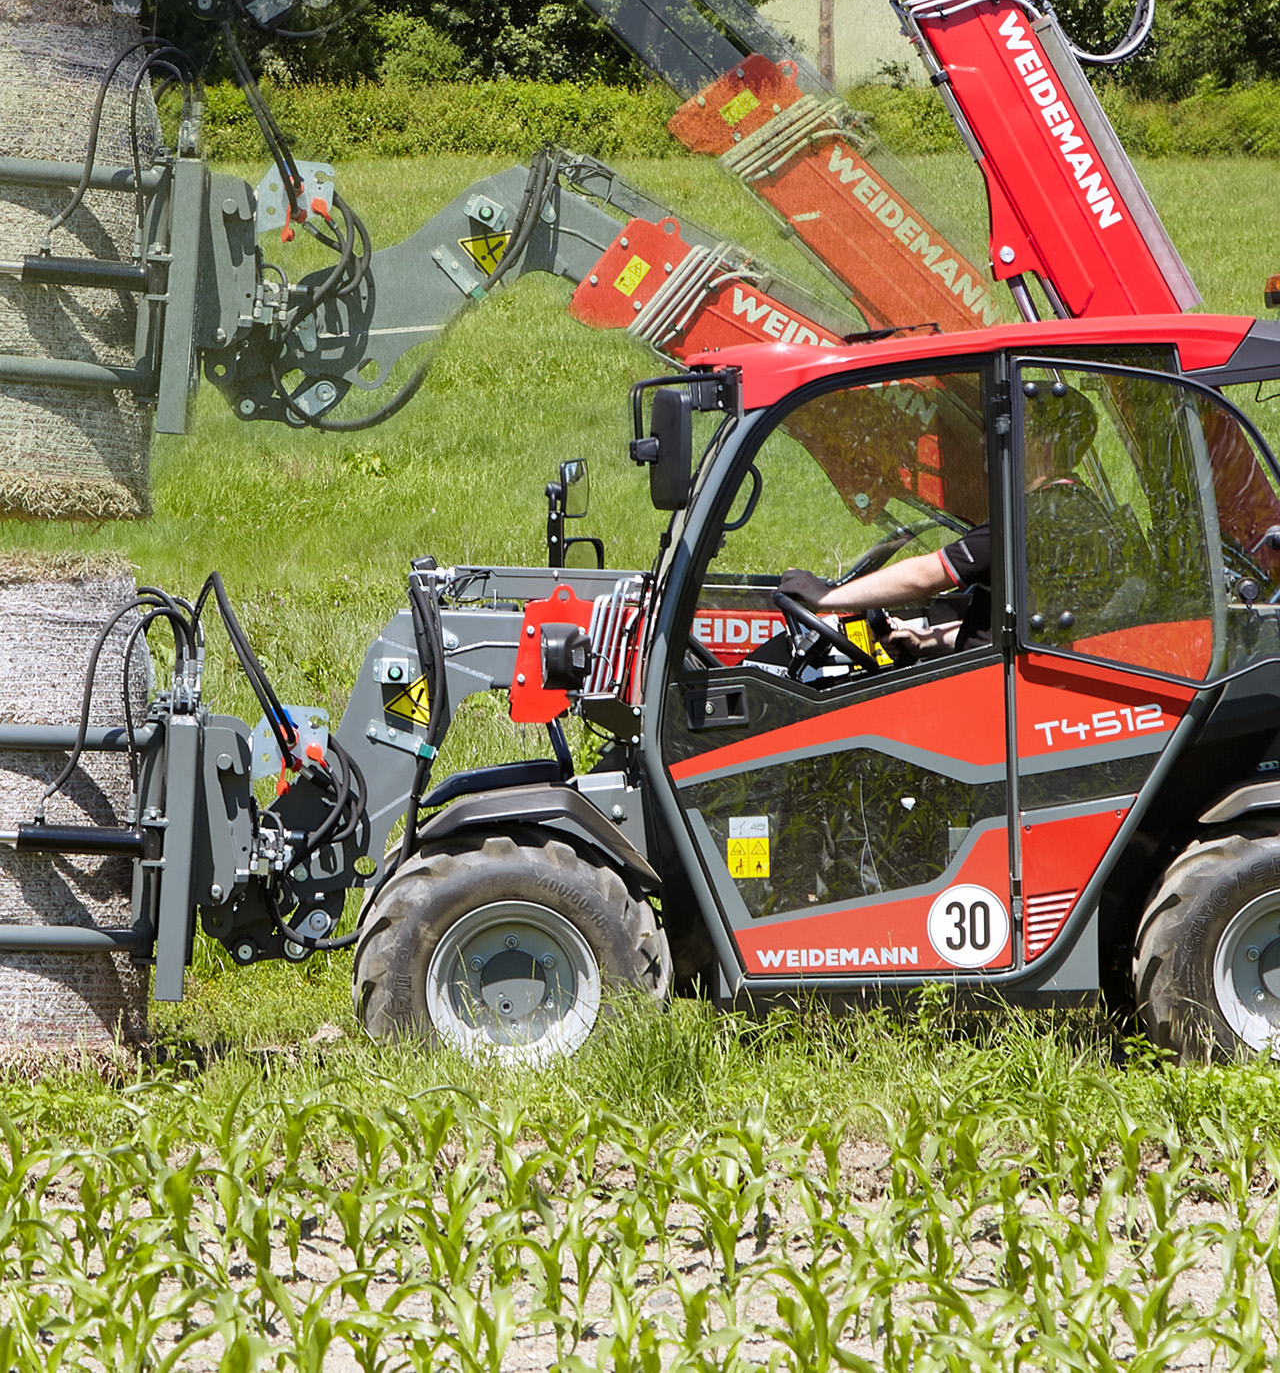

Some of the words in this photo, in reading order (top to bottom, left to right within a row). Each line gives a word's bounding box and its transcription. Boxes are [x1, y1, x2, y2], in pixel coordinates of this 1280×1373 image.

[998, 10, 1123, 230] WEIDEMANN
[827, 144, 1002, 327] WEIDEMANN
[732, 286, 837, 347] WEID
[1034, 704, 1165, 746] T4512
[945, 901, 991, 951] 30
[756, 946, 919, 968] WEIDEMANN
